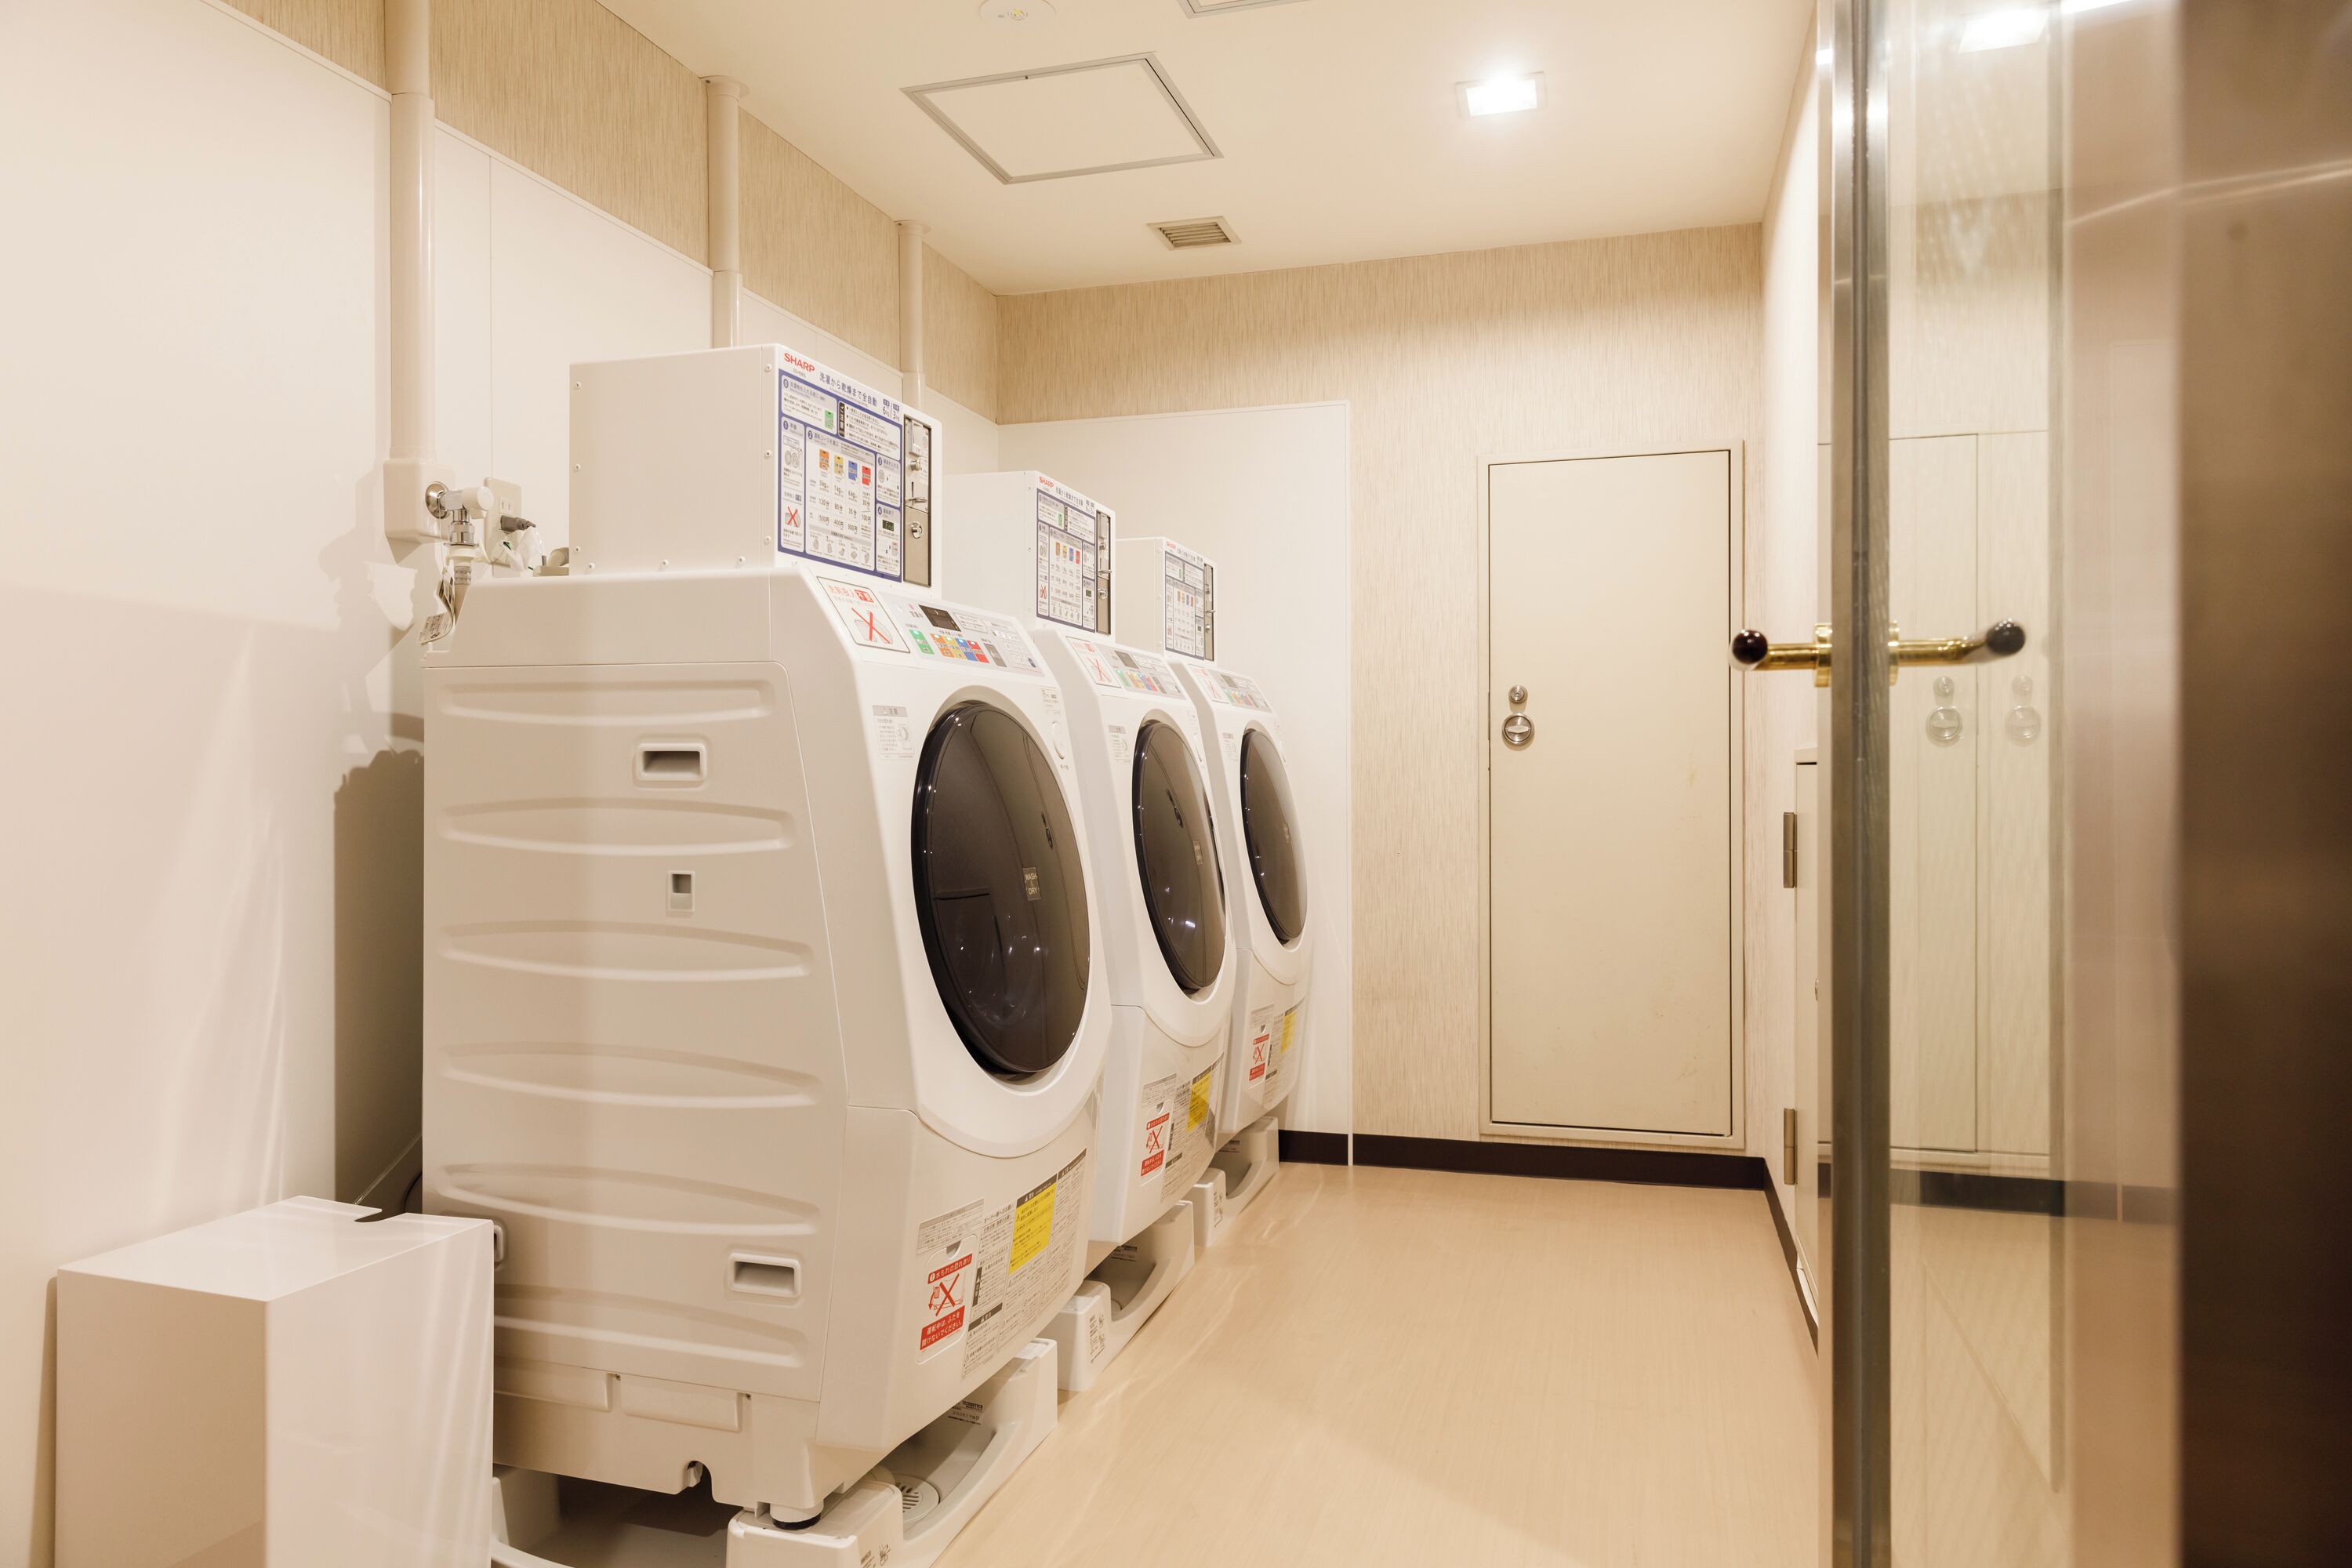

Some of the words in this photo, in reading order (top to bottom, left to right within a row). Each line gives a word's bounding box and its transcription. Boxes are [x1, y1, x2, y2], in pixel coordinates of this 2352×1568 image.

[784, 352, 815, 372] SHARP
[820, 372, 877, 407] 洗濯から乾燥まで全自動
[1039, 476, 1054, 487] SHARP
[1028, 887, 1038, 895] DRY
[935, 1256, 971, 1279] 水もれの恐れあり
[927, 1311, 960, 1335] 運転中は、ふたを
